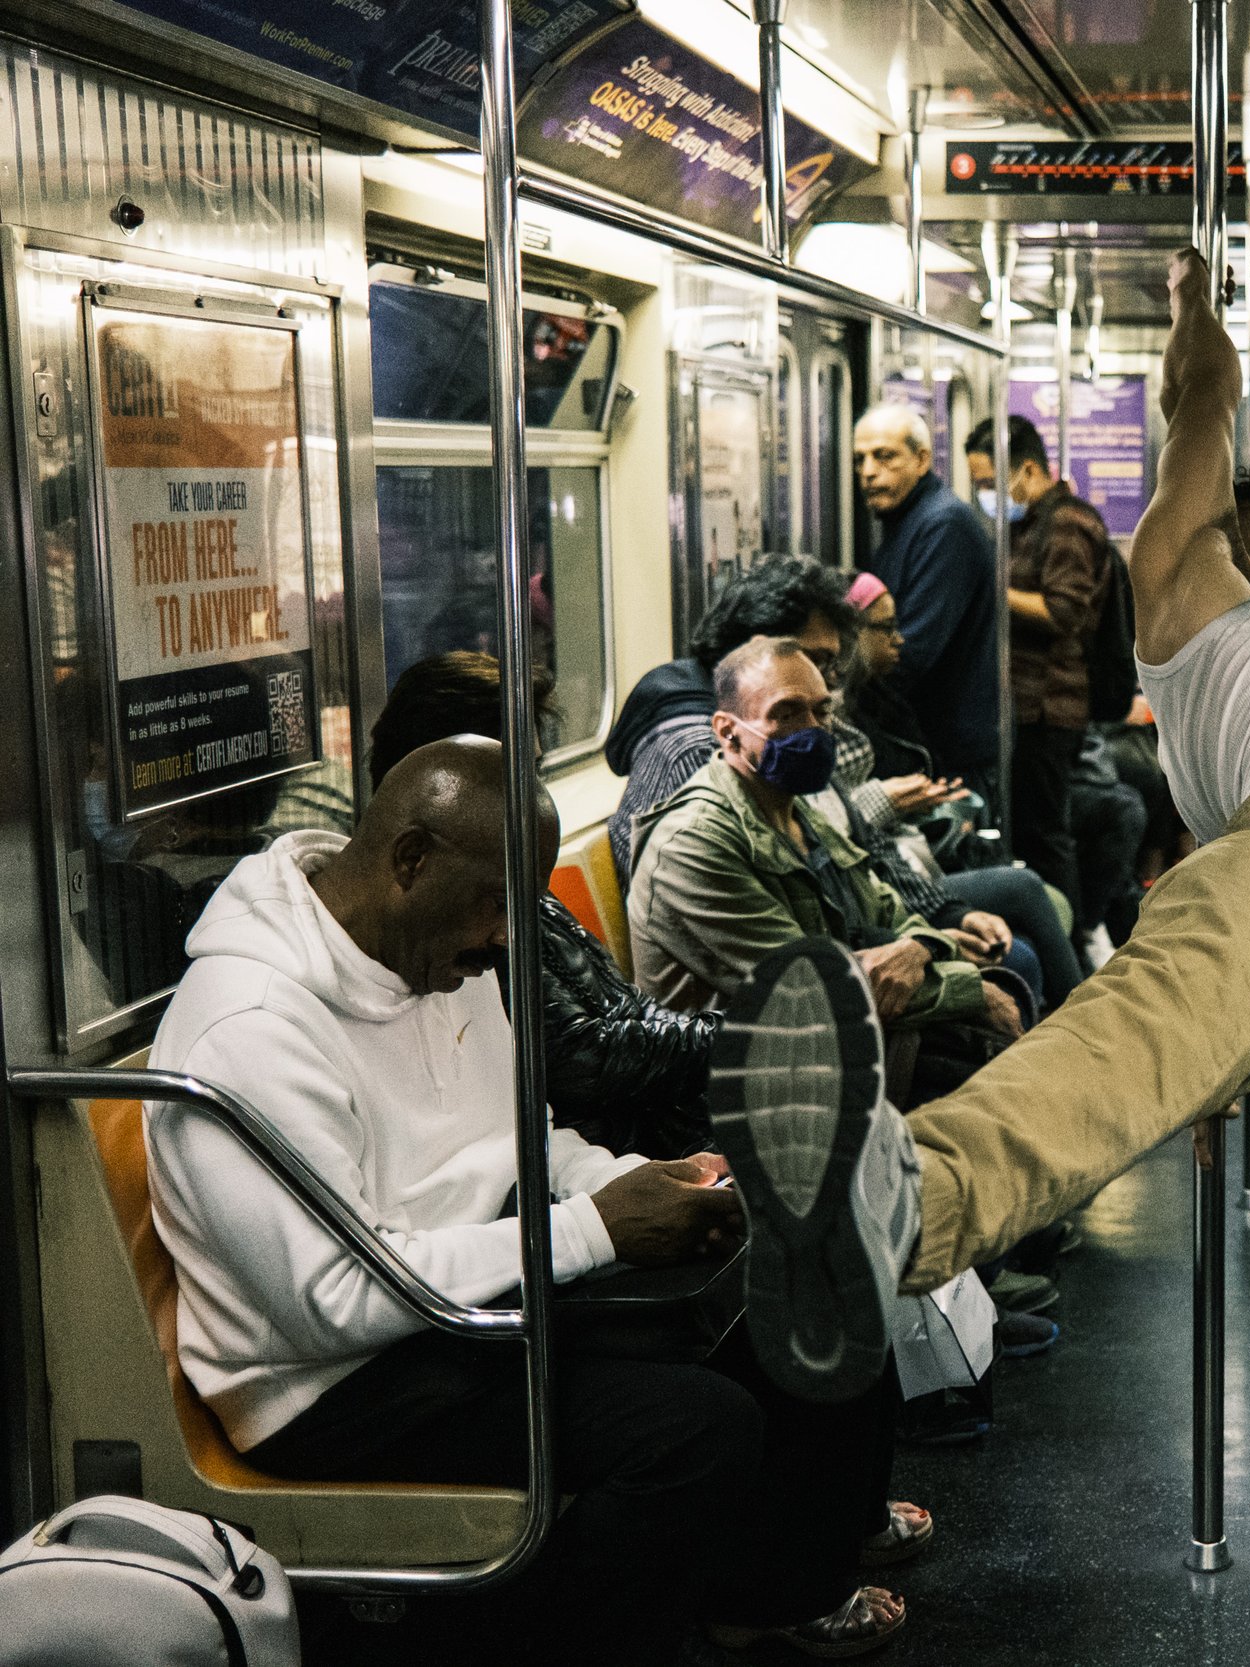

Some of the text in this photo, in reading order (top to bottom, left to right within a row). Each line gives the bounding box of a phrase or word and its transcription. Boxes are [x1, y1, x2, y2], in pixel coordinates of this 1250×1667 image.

[260, 20, 353, 70] WorkForPremier.com
[621, 55, 690, 107] Struggling
[679, 93, 716, 119] with
[590, 81, 646, 123] OASAS
[632, 104, 655, 130] is
[645, 113, 679, 143] here.
[671, 127, 711, 163] Every
[167, 481, 247, 512] TAKE YOUR CAREER
[132, 519, 258, 586] FROM HERE...
[155, 585, 289, 657] TO ANYWHERE.
[128, 684, 249, 717] Add powerful skills to your resume
[128, 713, 213, 741] in as little as 8 weeks.
[132, 758, 158, 789] Learn
[158, 754, 182, 782] more
[196, 730, 268, 772] CERTIFI.MERCY.EDU
